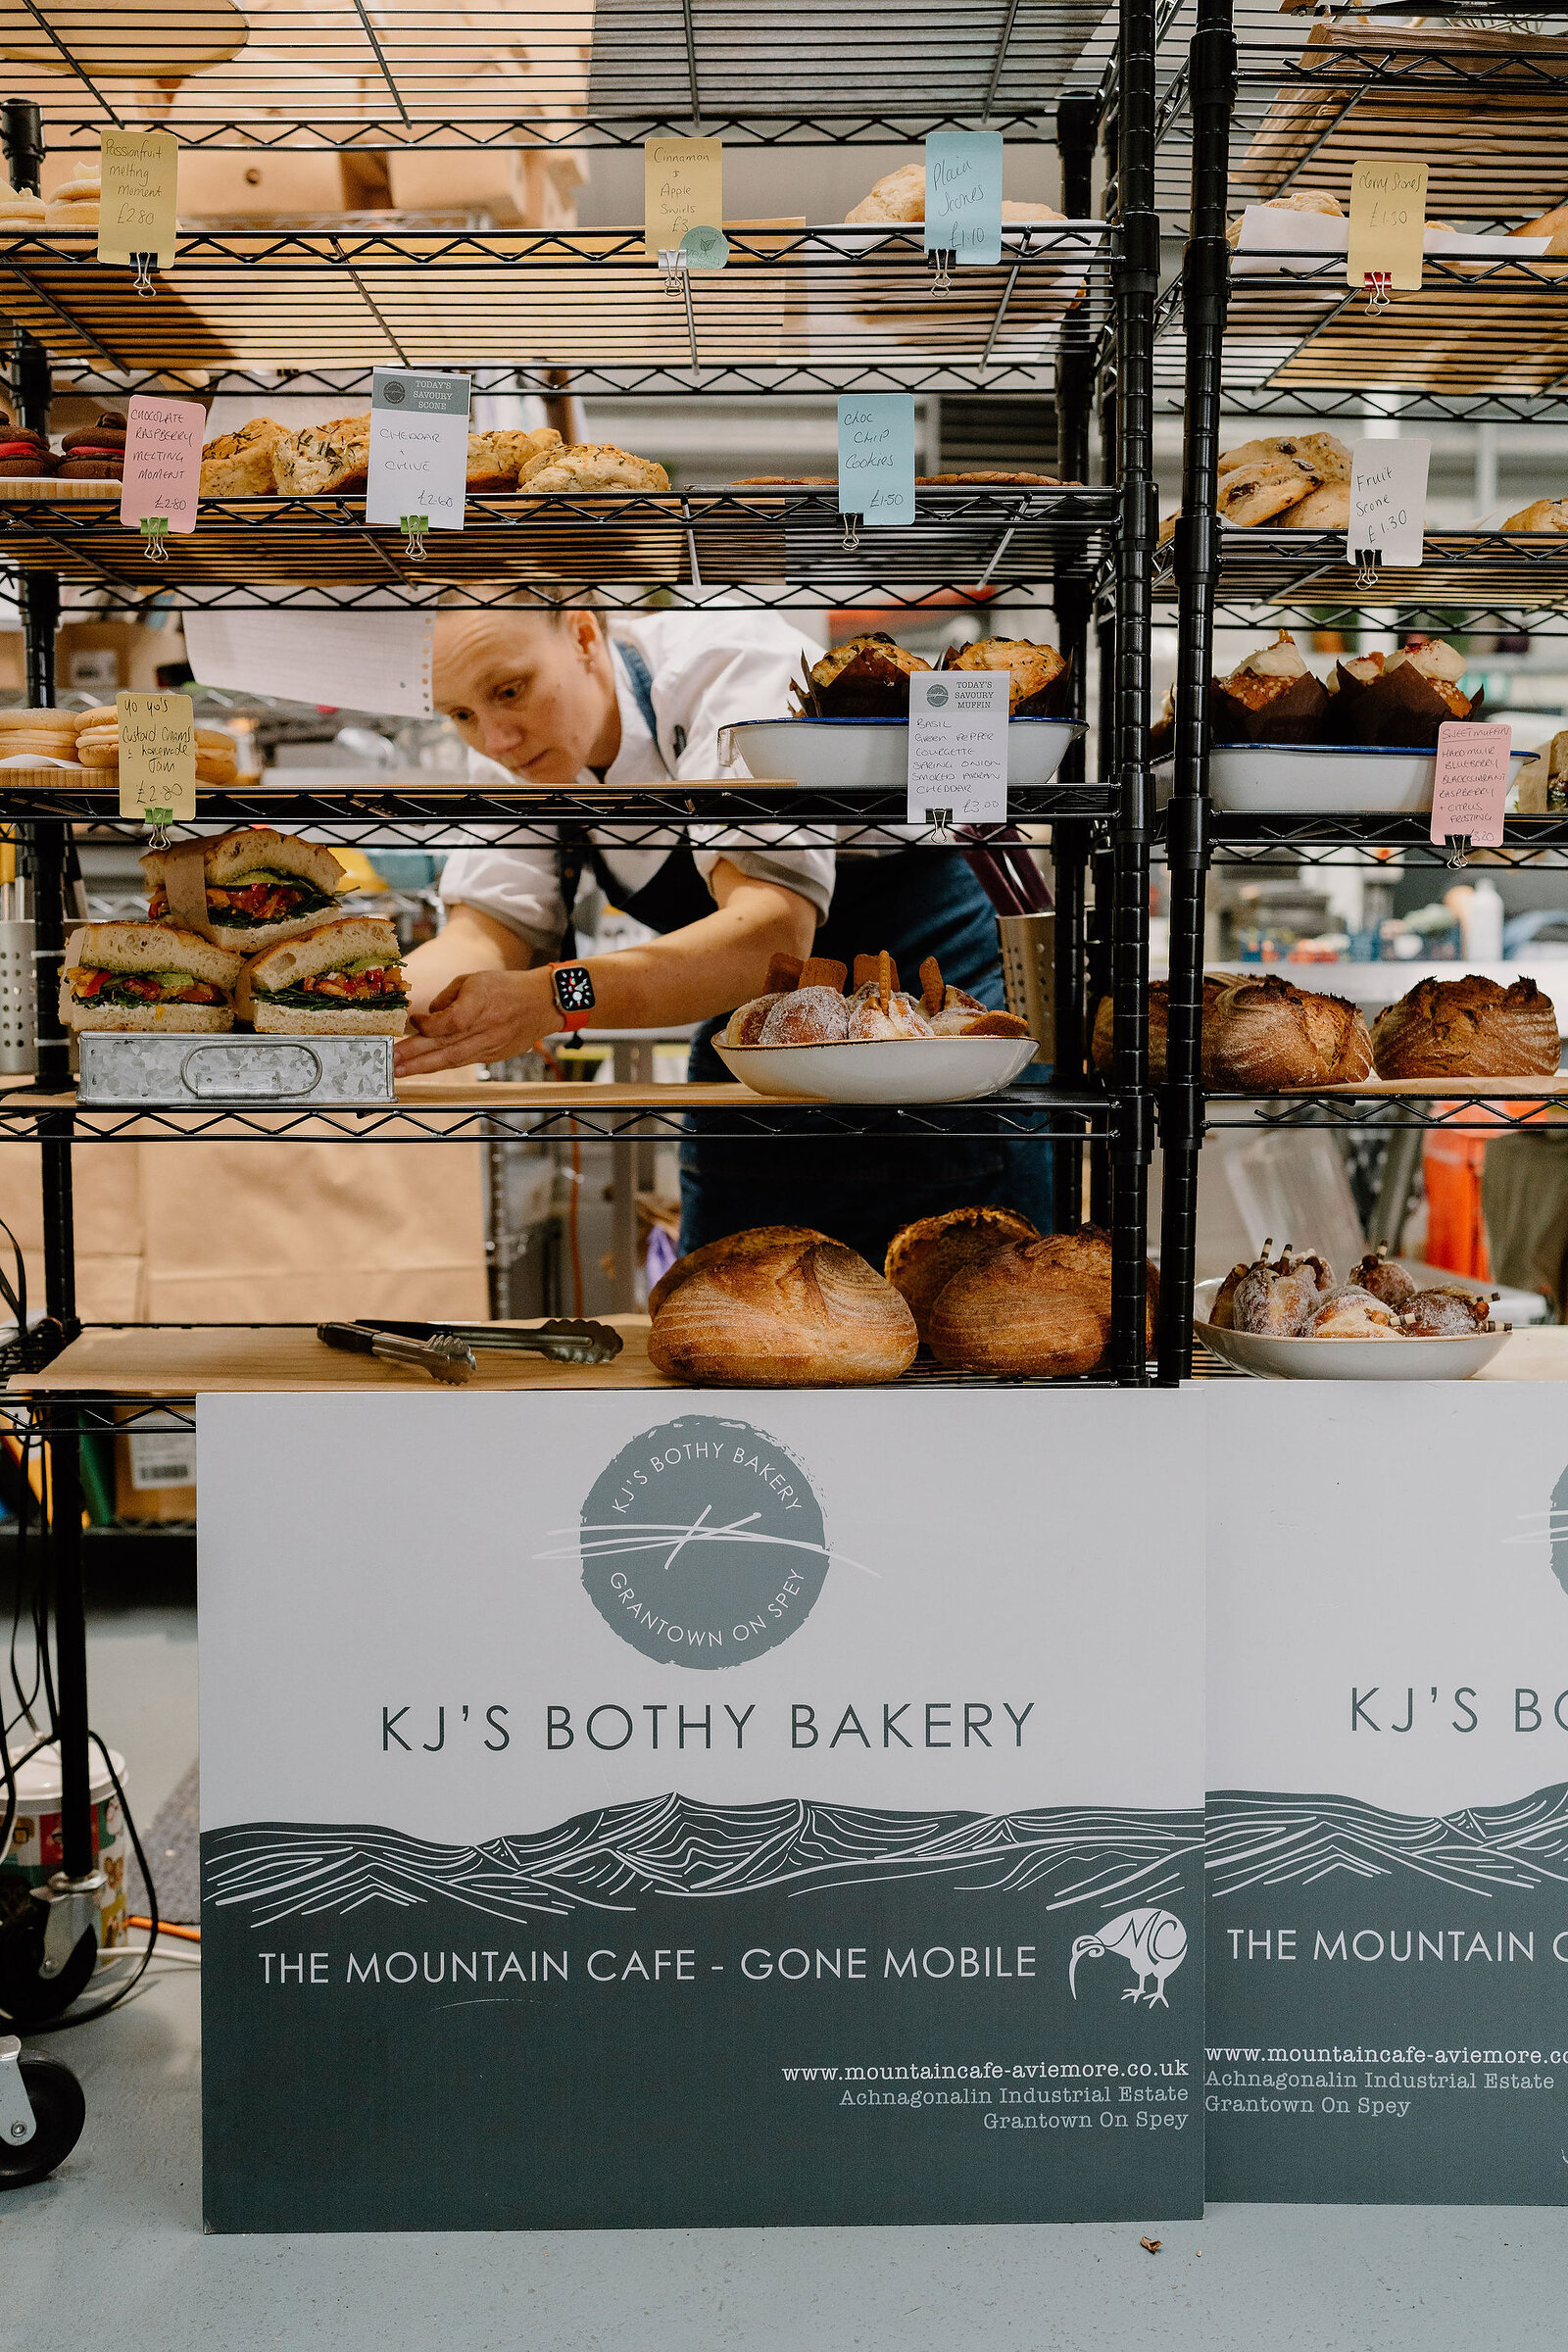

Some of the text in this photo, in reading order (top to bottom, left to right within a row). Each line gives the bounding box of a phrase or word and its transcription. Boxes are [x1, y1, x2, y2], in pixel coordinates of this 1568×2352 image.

[654, 146, 710, 164] Cinnamon
[933, 156, 972, 191] Plain
[661, 182, 691, 199] Apple
[939, 183, 984, 217] Scones
[950, 221, 985, 248] £1.10
[415, 380, 452, 390] TODAY'S
[413, 391, 453, 401] SAVOURY
[417, 401, 447, 410] SCONE
[130, 409, 184, 423] CHOCOLATE
[135, 426, 193, 447] RASPBERRY
[379, 428, 441, 443] CHEDDAR
[132, 451, 184, 463] MELTING
[1356, 466, 1393, 492] Fruit
[1355, 494, 1391, 517] Scone
[955, 691, 995, 700] SAVOURY
[956, 681, 993, 690] TODAY'S
[916, 717, 953, 729] BASIL
[148, 757, 175, 773] Jam
[916, 784, 972, 794] CHEDDAR
[1447, 802, 1483, 812] CITRUS
[612, 1442, 803, 1513] KJ'S BOTHY BAKERY
[611, 1568, 805, 1647] GRANTOWN ON SPEY
[1351, 1687, 1478, 1734] KJ'S
[382, 1702, 1035, 1752] KJ'S BOTHY BAKERY
[1227, 1929, 1297, 1960] THE
[1313, 1929, 1534, 1962] MOUNTAIN
[259, 1952, 329, 1984] THE
[345, 1950, 568, 1984] MOUNTAIN
[586, 1949, 696, 1982] CAFE
[740, 1947, 867, 1980] GONE
[884, 1945, 1036, 1979] MOBILE
[782, 2059, 1189, 2082] www.mountaincafe-aviemore.co.uk
[1204, 2070, 1554, 2090] Achnagonalin Industrial Estate
[839, 2085, 1188, 2108] Achnagonalin Industrial Estate
[1204, 2095, 1411, 2118] Grantown On Spey
[983, 2110, 1189, 2132] Grantown On Spey
